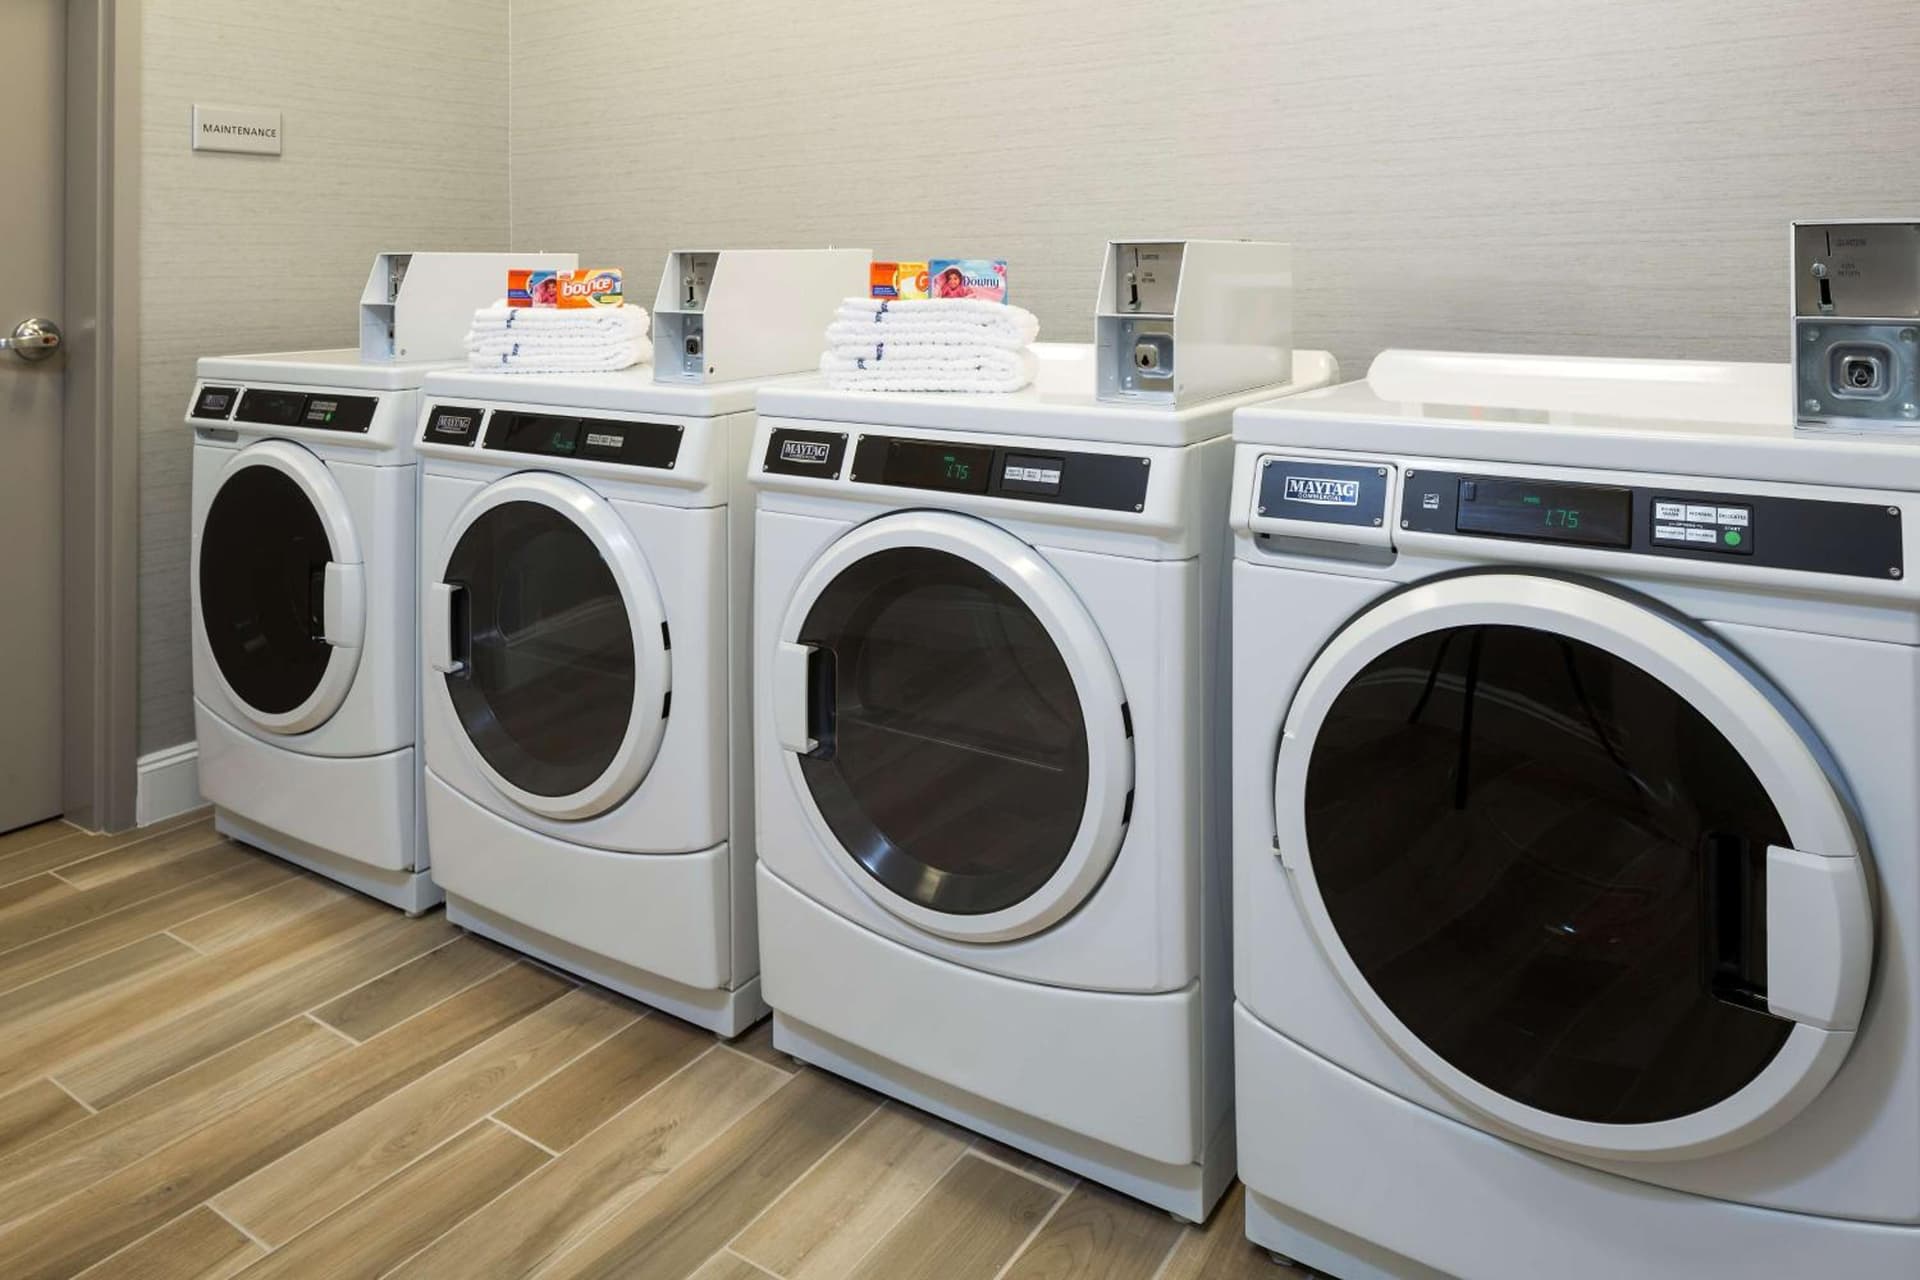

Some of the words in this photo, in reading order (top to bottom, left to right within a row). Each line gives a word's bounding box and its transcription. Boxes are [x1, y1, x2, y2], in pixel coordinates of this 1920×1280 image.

[202, 123, 277, 138] MAINTENANCE
[562, 278, 611, 297] bounce
[963, 275, 999, 289] Downy
[785, 443, 826, 457] MAYTAG
[1288, 479, 1354, 497] MAYTAG
[1297, 492, 1343, 502] COMMERCIAL
[1544, 509, 1579, 528] 1.75
